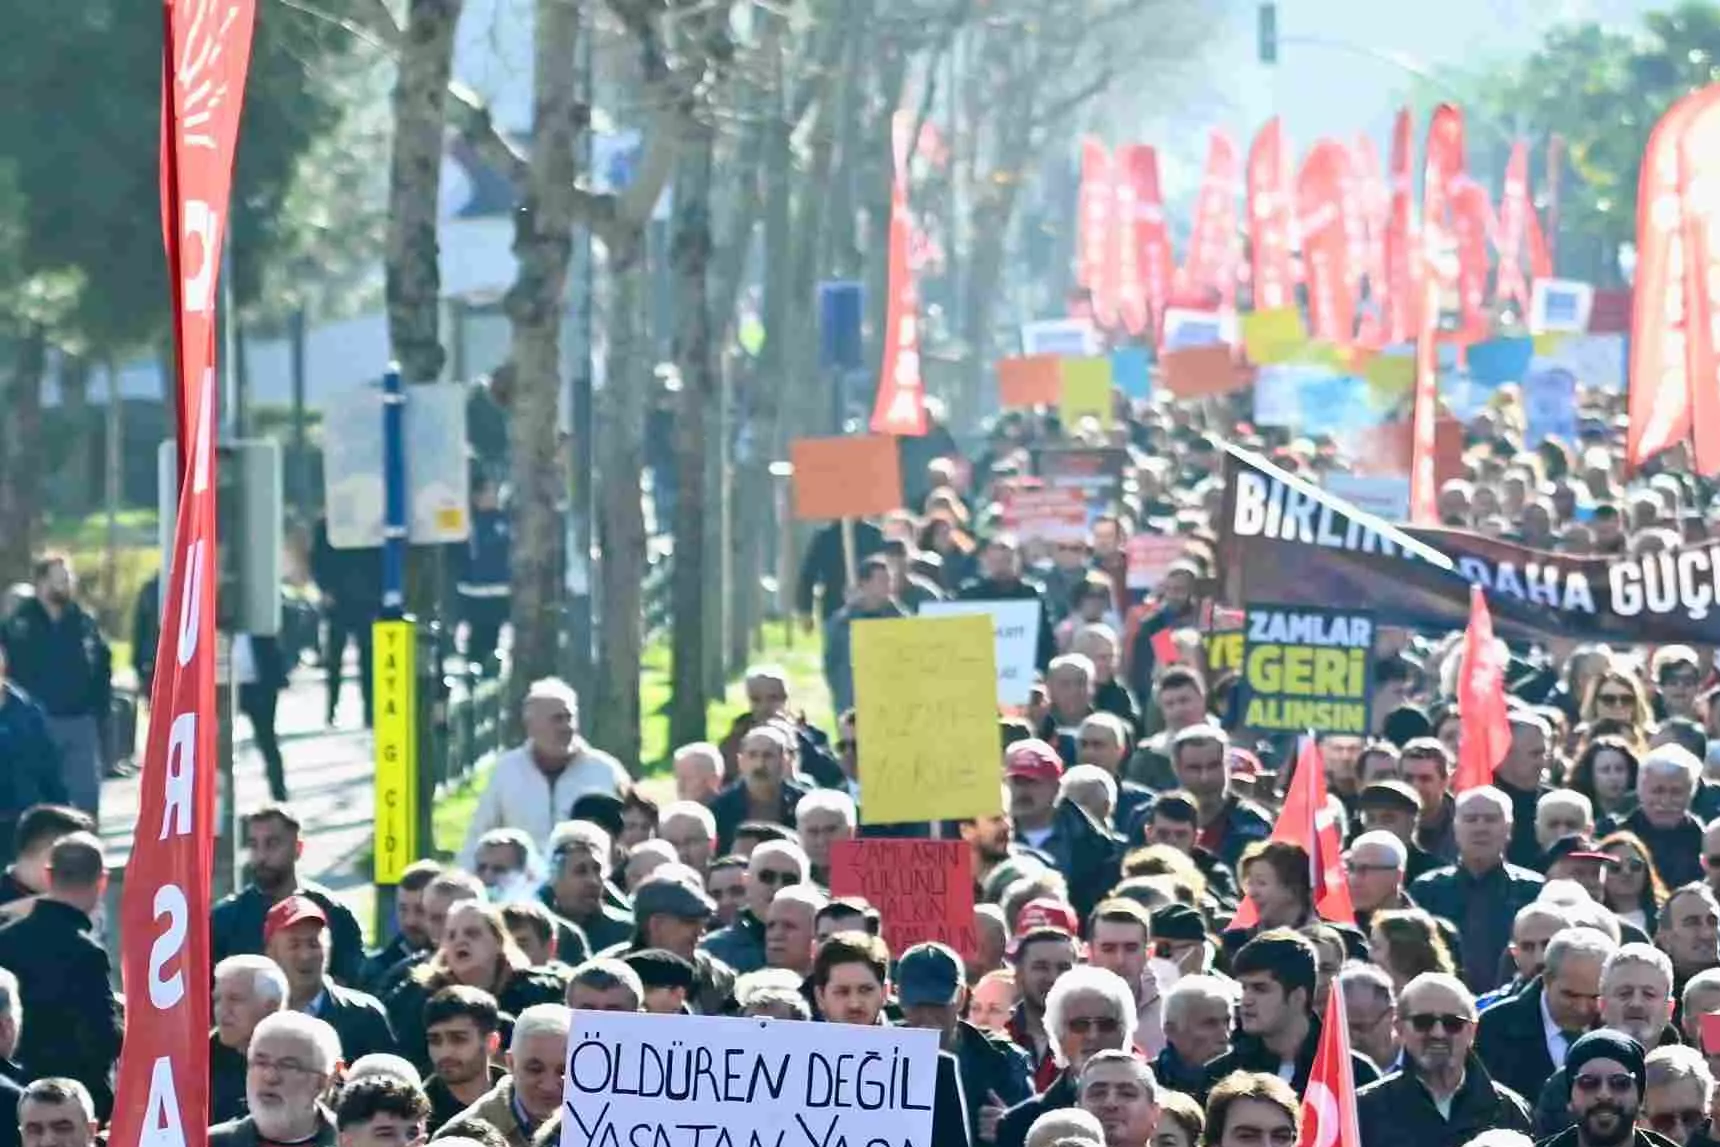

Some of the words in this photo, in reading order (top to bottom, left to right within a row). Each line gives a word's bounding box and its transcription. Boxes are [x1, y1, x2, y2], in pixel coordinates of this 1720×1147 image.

[1249, 610, 1372, 647] ZAMLAR
[1248, 646, 1366, 697] GERİ
[1245, 698, 1368, 733] ALINSIN
[569, 1031, 791, 1103] ÖLDÜREN
[805, 1046, 932, 1111] DEĞİL
